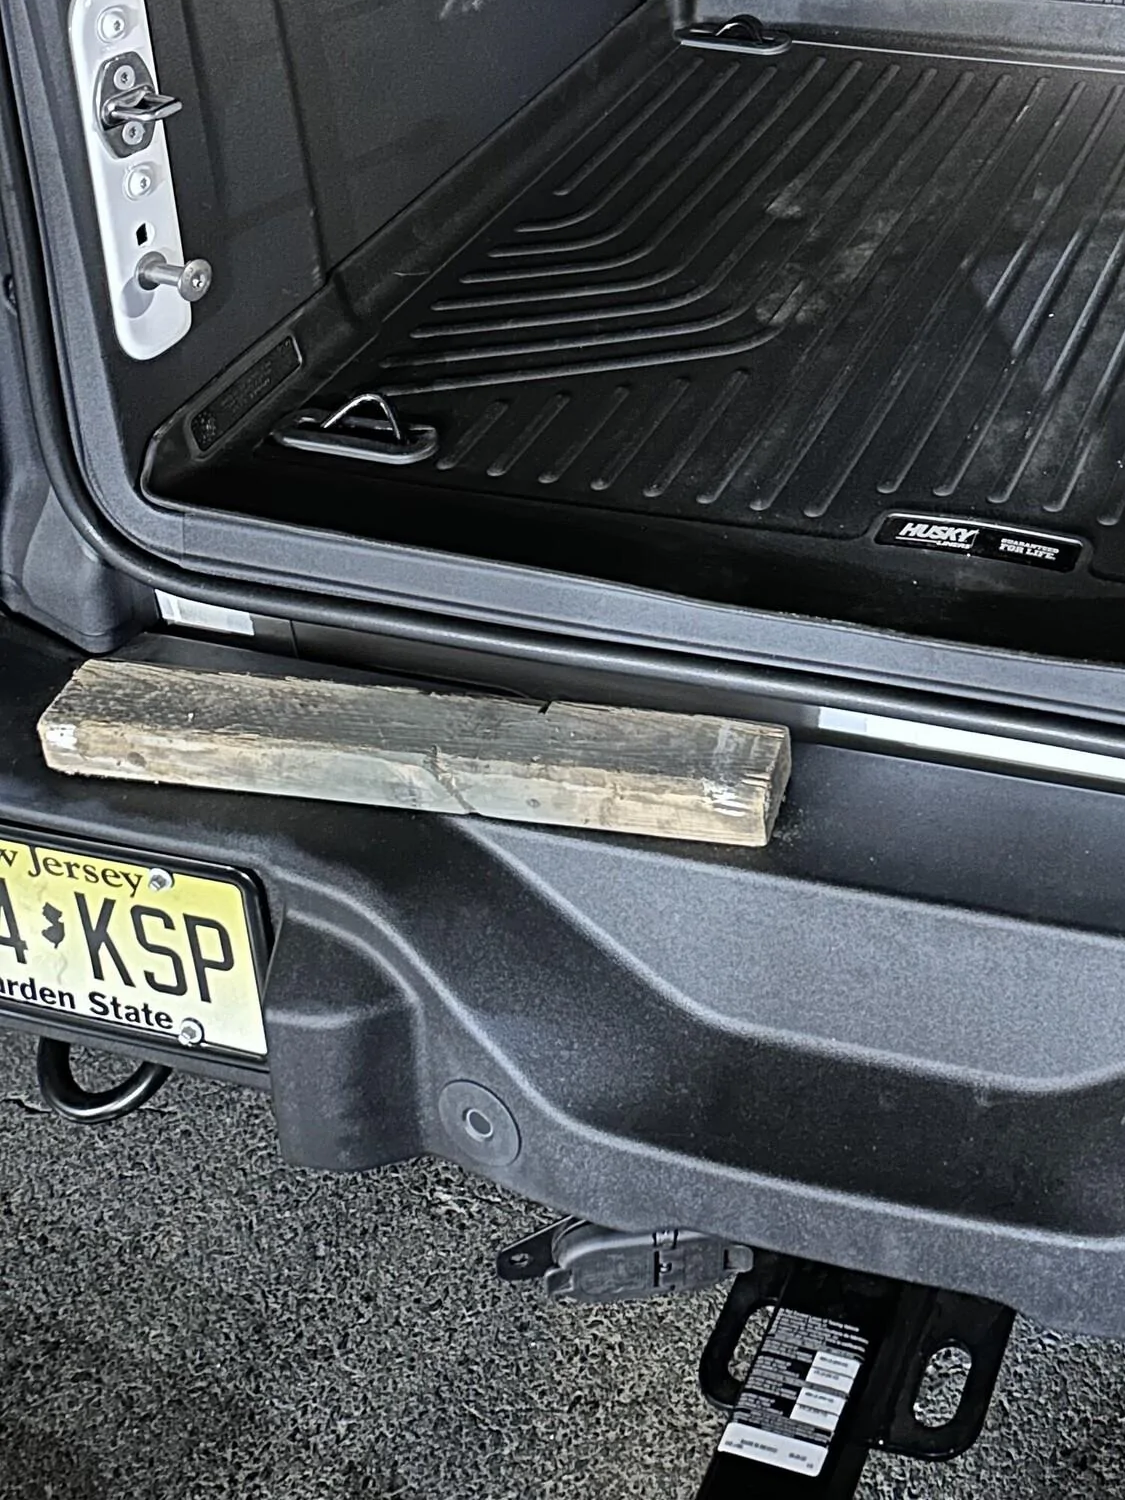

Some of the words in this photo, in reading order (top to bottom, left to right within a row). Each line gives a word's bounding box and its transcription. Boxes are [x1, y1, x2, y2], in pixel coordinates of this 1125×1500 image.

[898, 522, 980, 543] HUSKY
[999, 543, 1025, 554] FOR
[27, 845, 144, 898] Jersey
[74, 891, 235, 1004] KSP
[88, 990, 174, 1030] State
